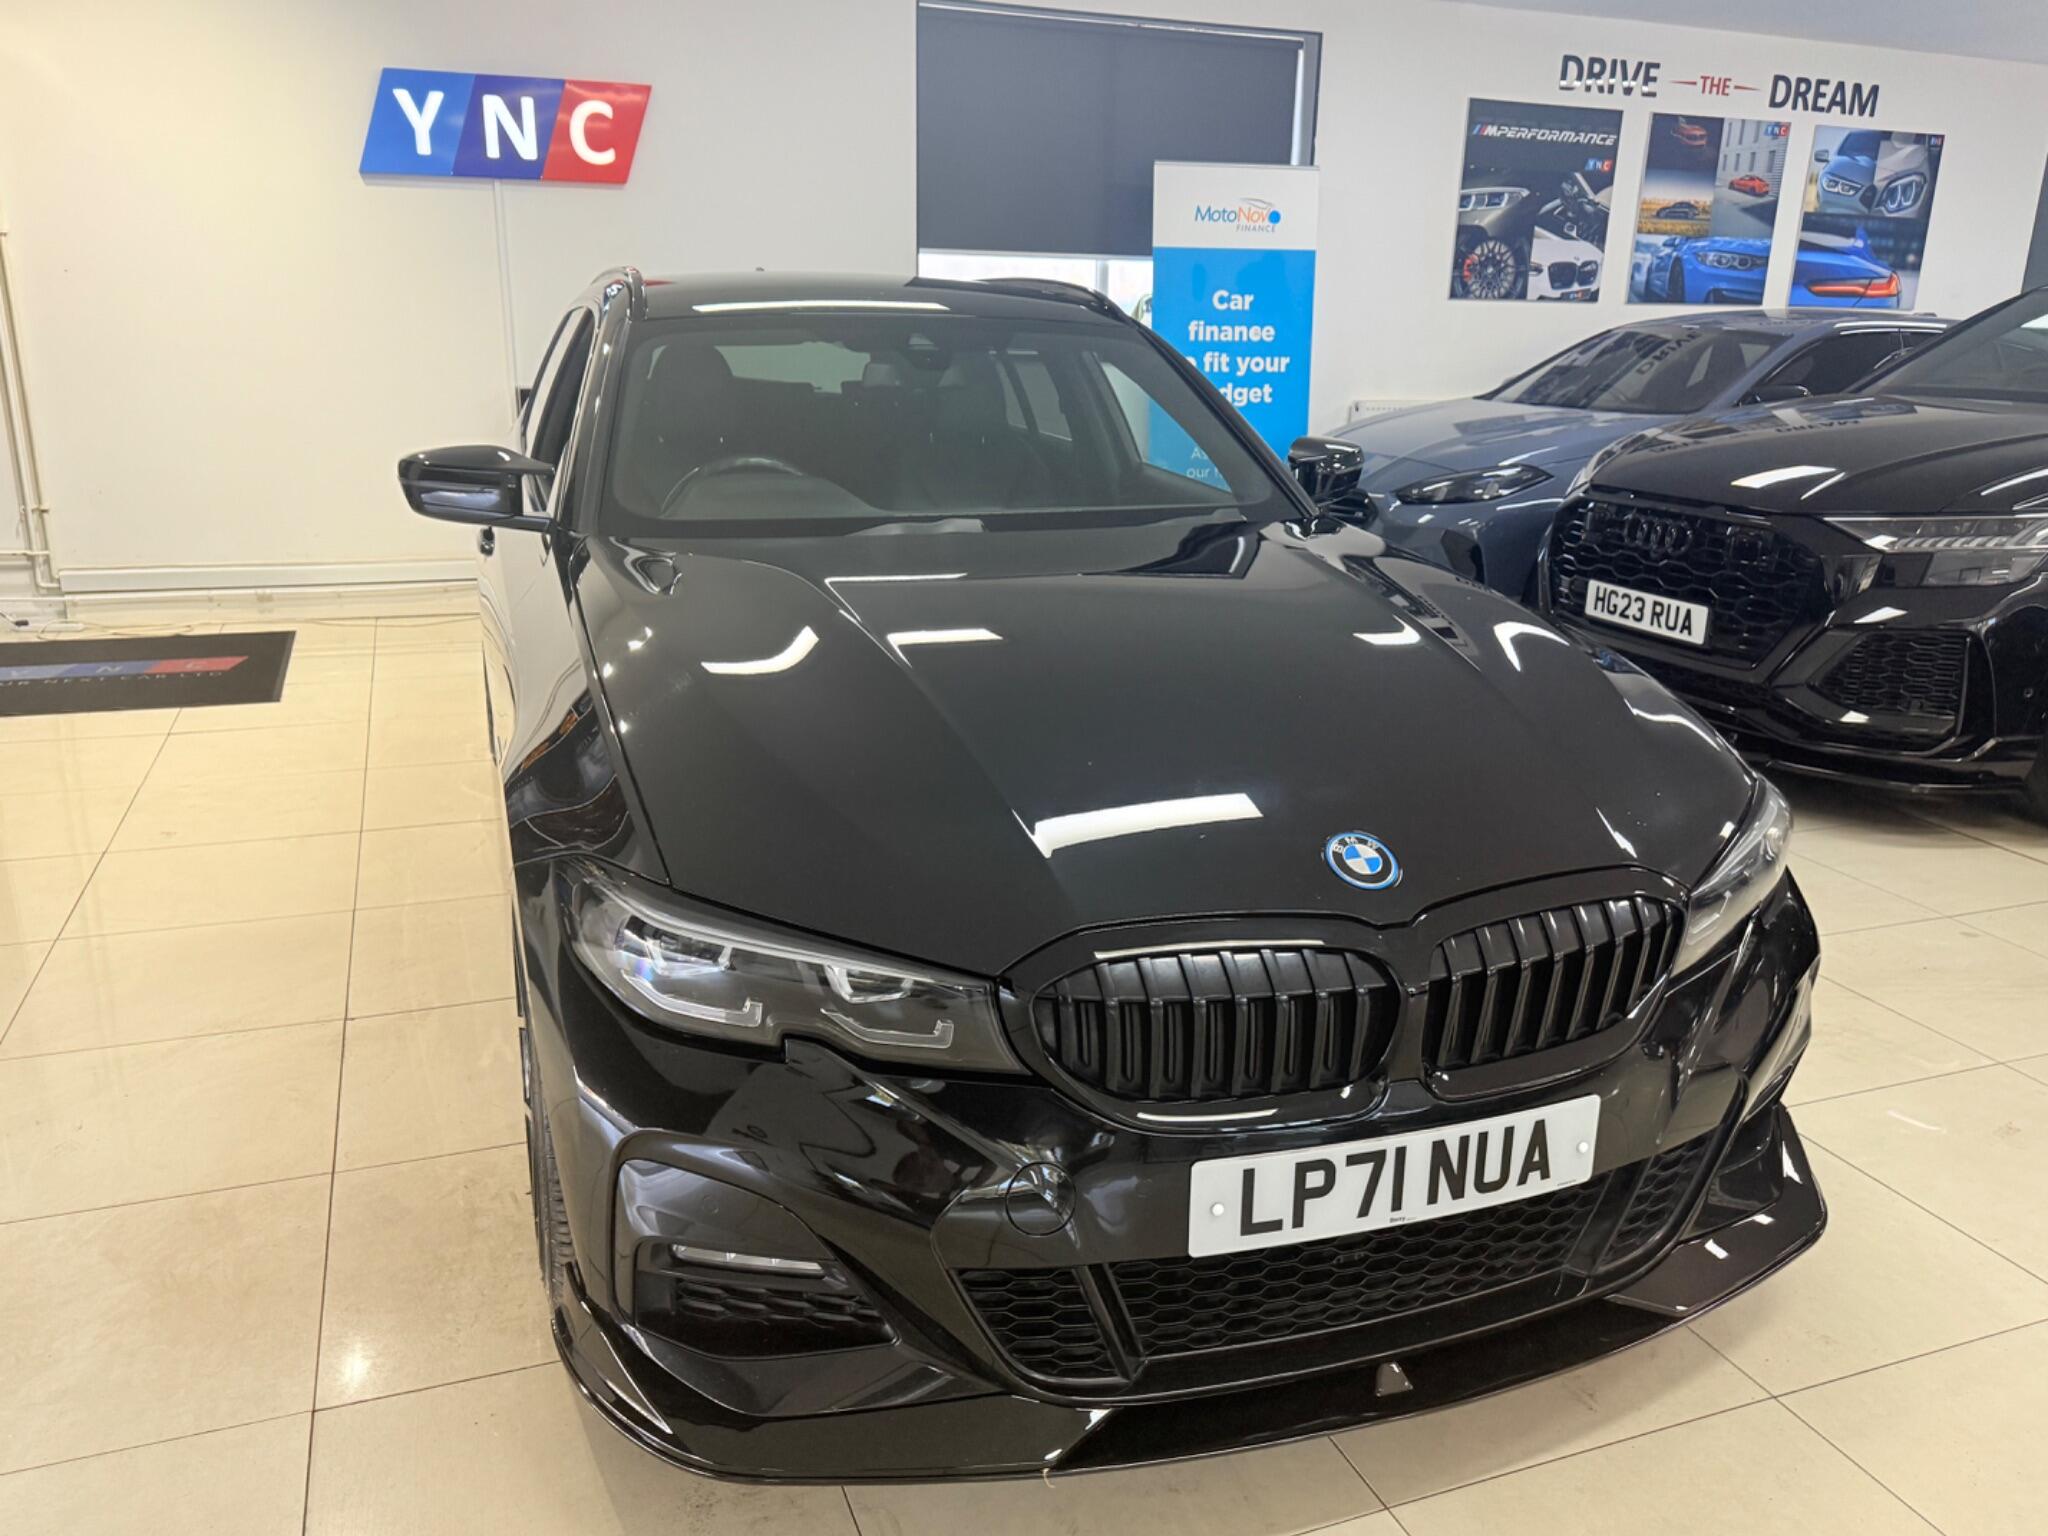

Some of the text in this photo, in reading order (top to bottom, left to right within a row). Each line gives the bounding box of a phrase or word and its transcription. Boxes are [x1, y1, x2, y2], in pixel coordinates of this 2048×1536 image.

[1559, 54, 1880, 117] DRIVE THE DREAM
[392, 88, 616, 166] YNC
[1236, 223, 1276, 233] FINANCE
[1212, 289, 1254, 311] Car
[1188, 321, 1276, 342] finance
[1203, 351, 1230, 373] fit
[1236, 356, 1290, 377] your
[1219, 382, 1273, 407] dget
[1593, 585, 1693, 637] HG23 RUA
[1239, 1118, 1551, 1237] LP71 NUA
